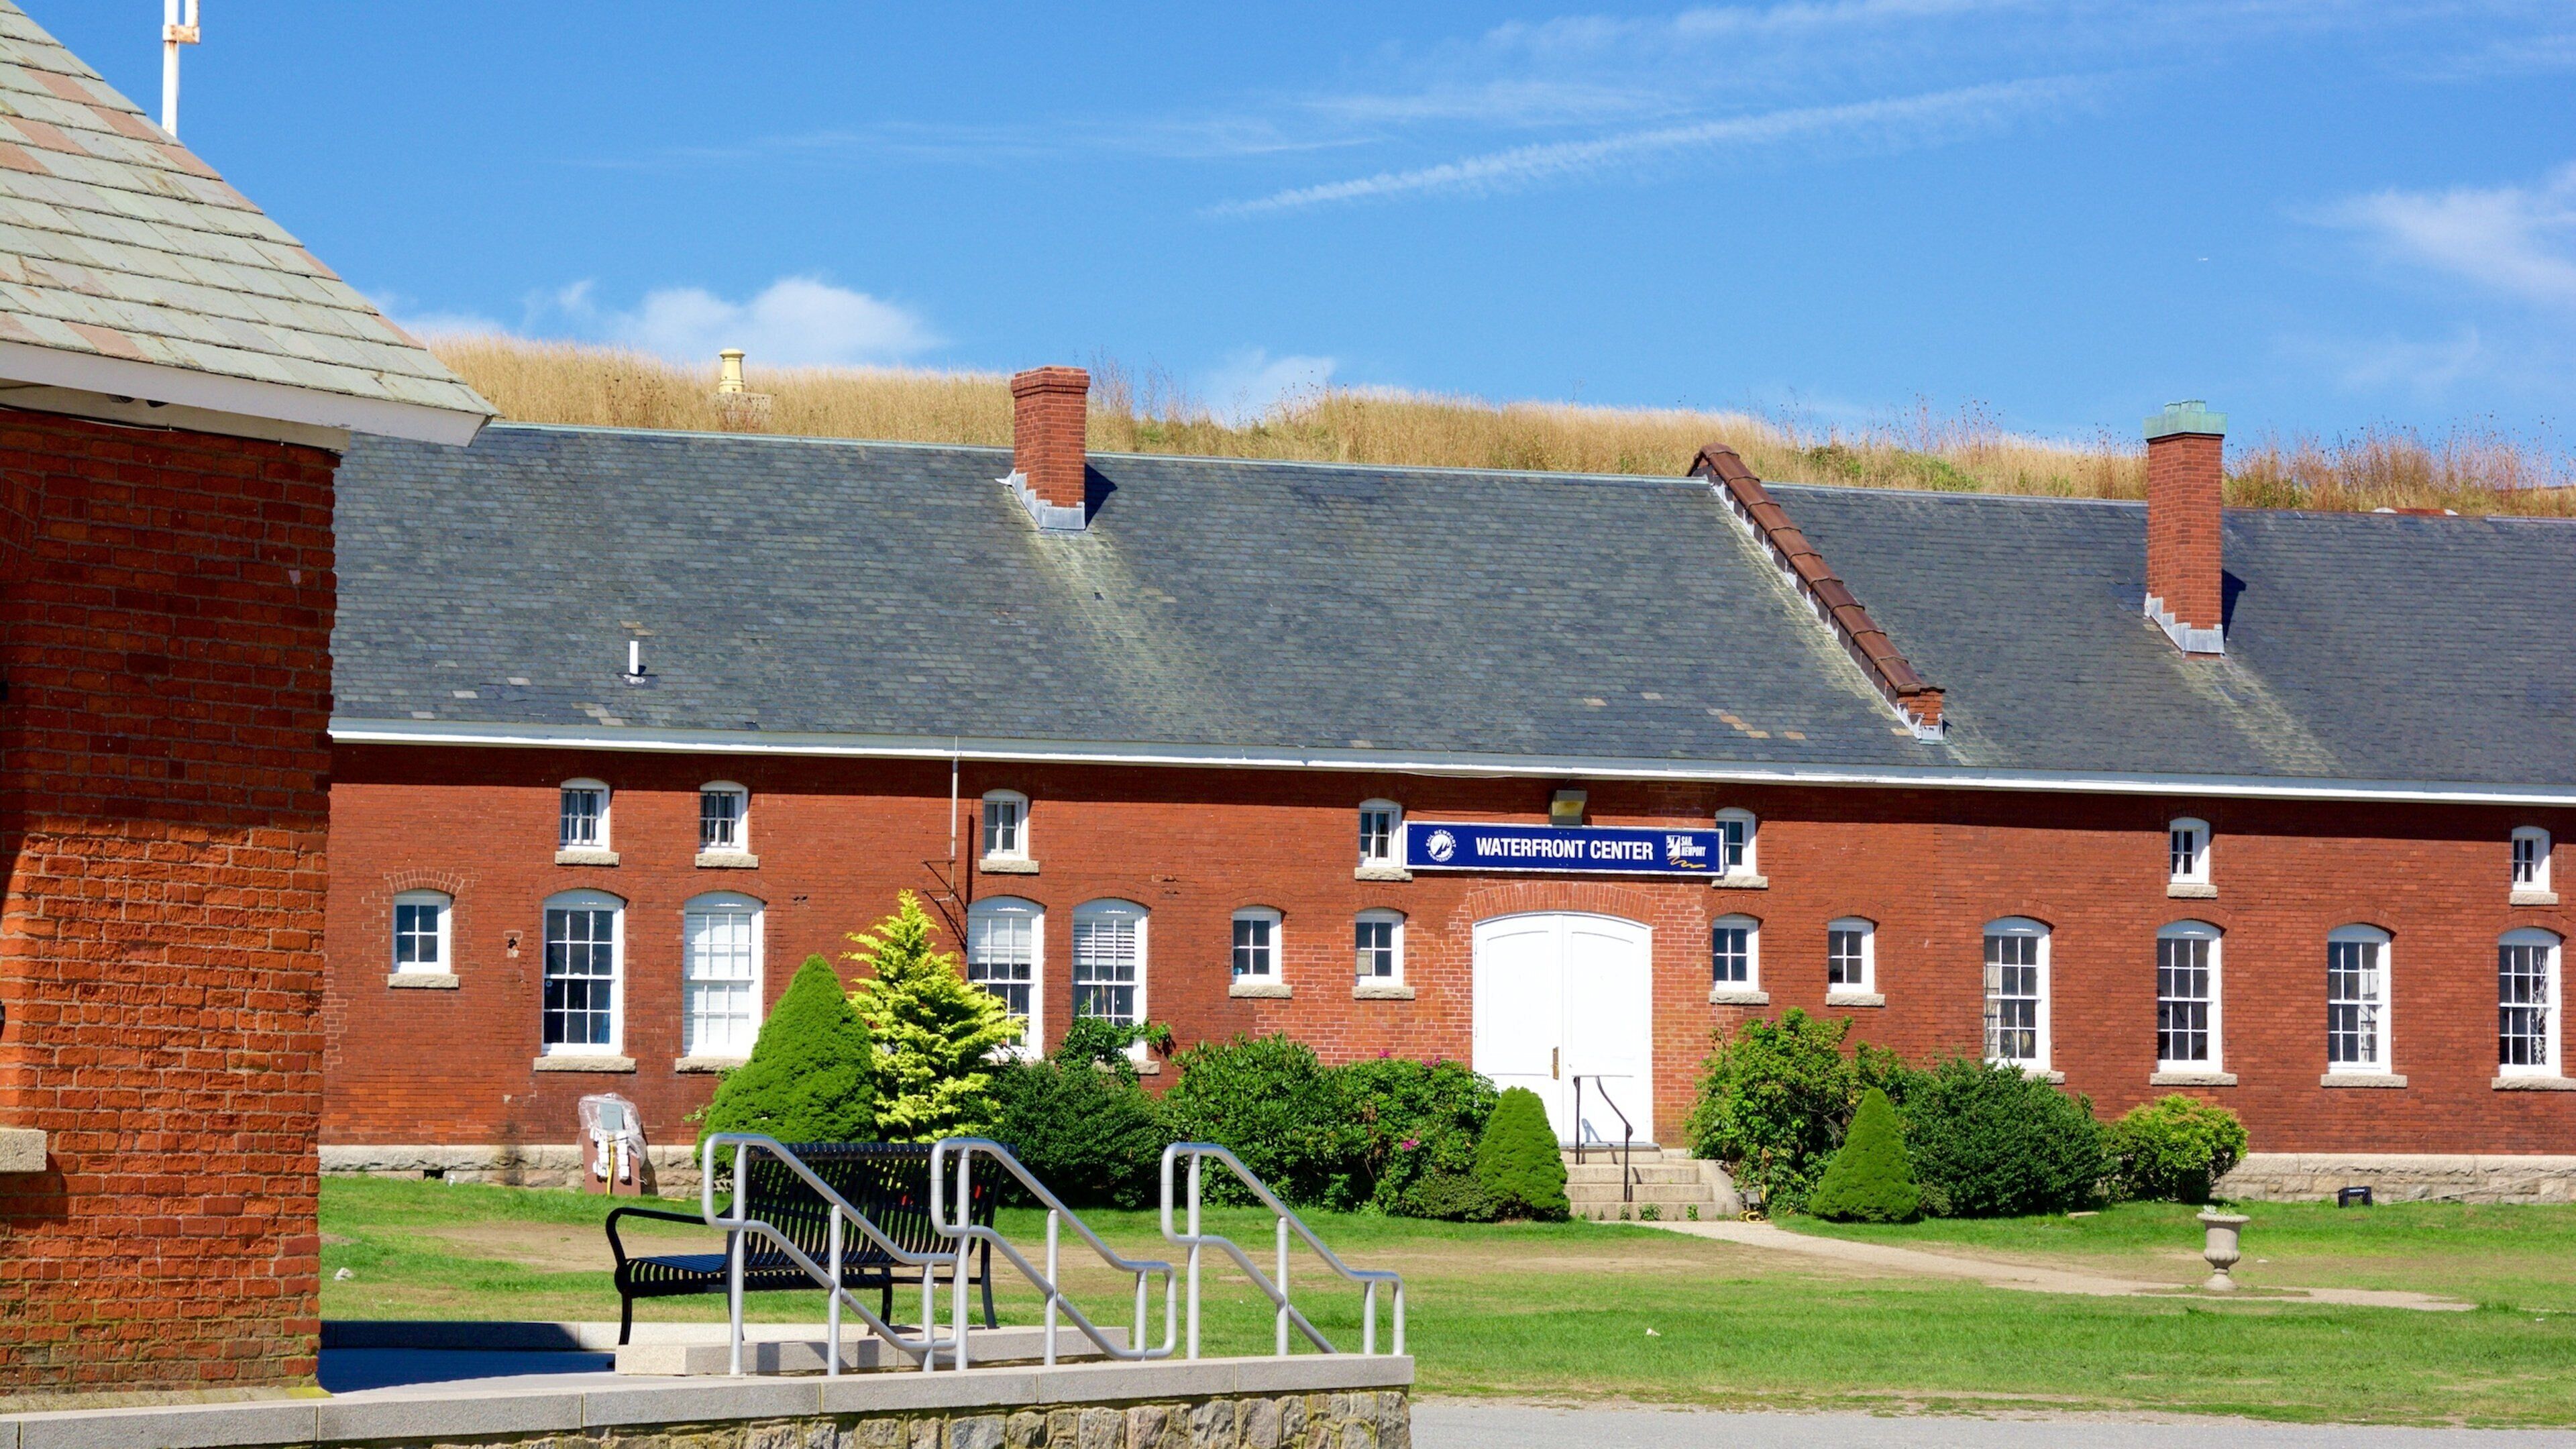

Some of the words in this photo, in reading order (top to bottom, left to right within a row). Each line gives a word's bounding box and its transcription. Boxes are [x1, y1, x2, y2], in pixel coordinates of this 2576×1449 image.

[1434, 829, 1456, 848] NEWPORT
[1681, 835, 1693, 846] SAIL
[1475, 837, 1586, 859] WATERFRONT
[1590, 840, 1654, 860] CENTER
[1681, 846, 1706, 857] NEWPORT
